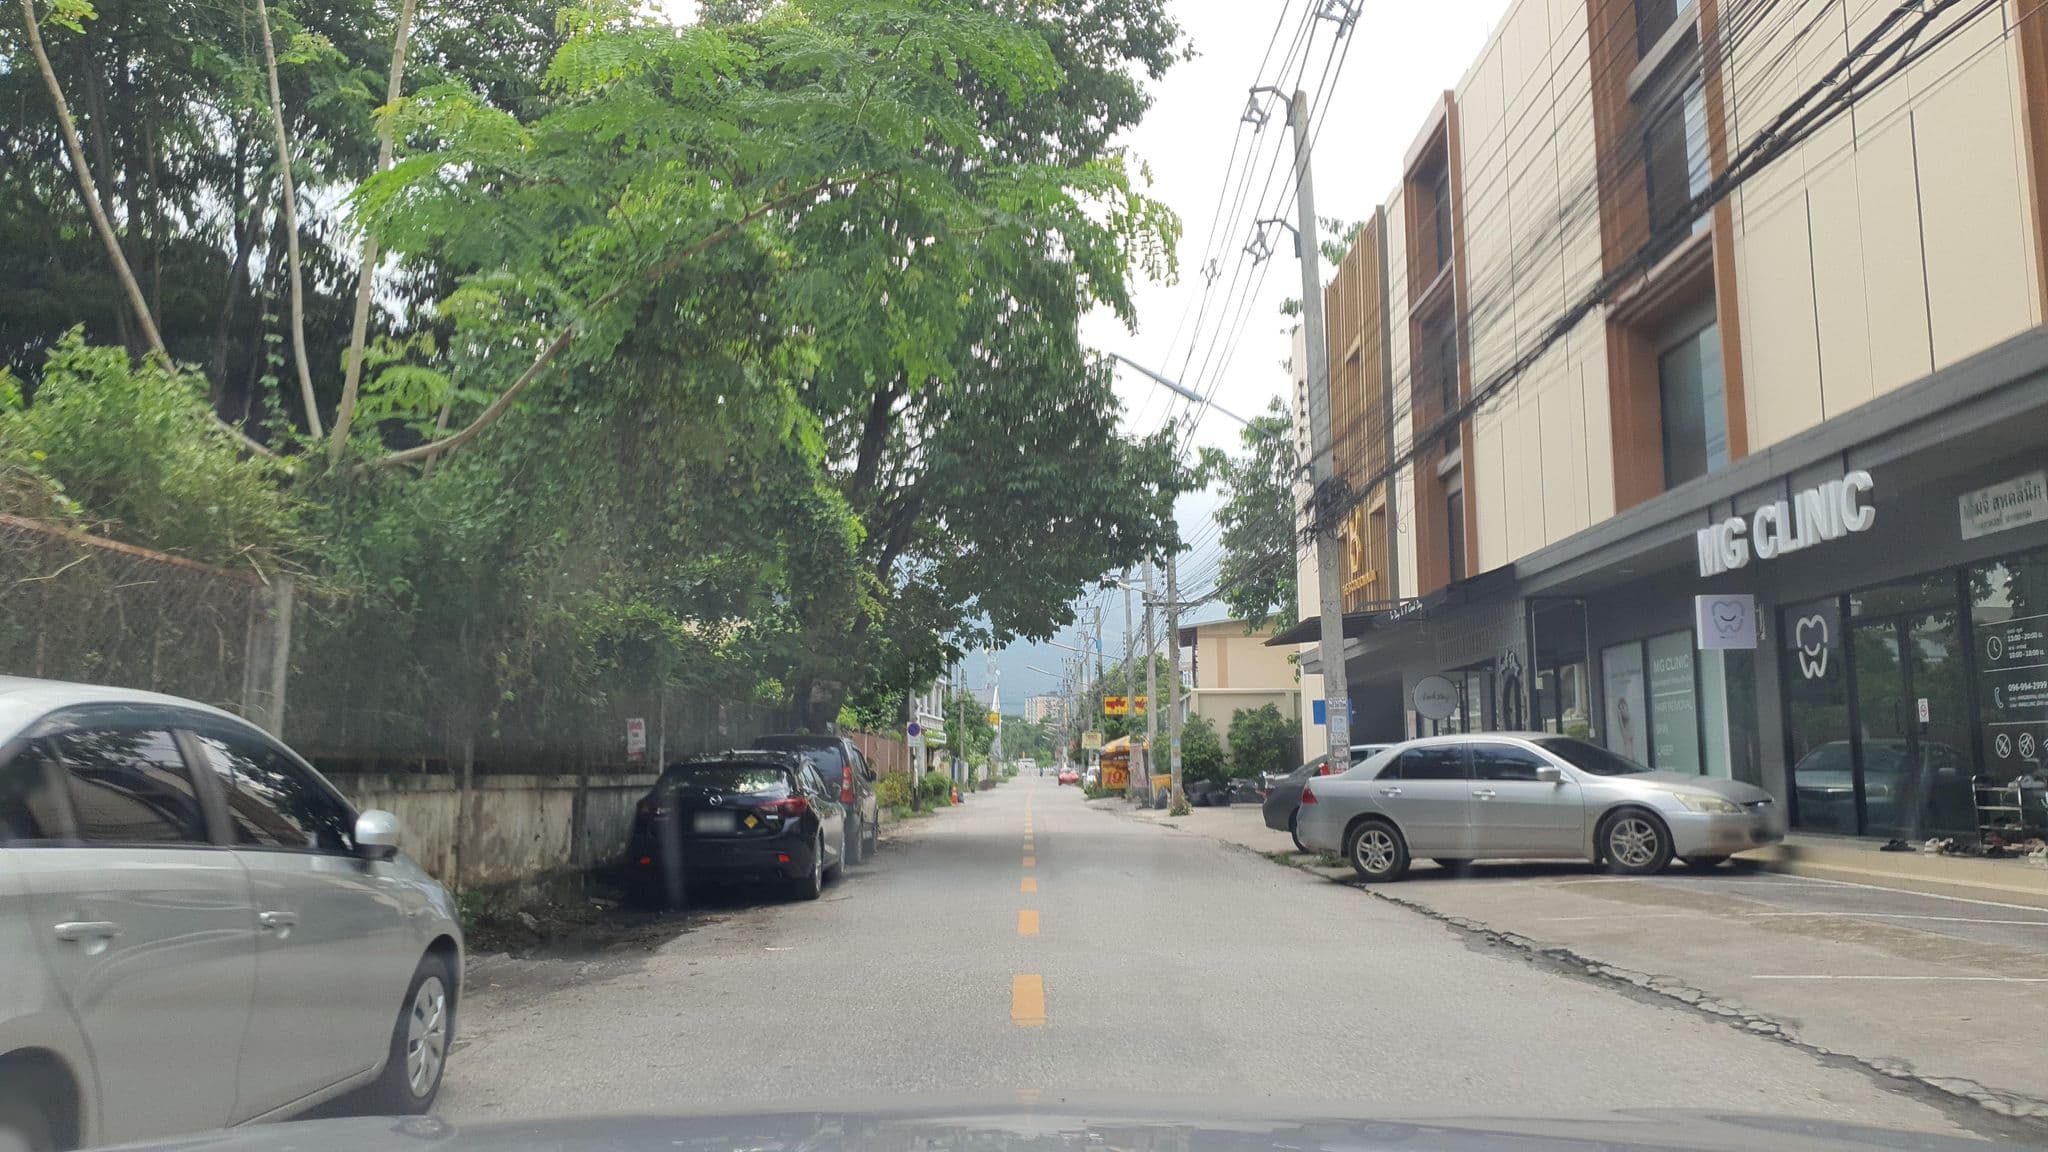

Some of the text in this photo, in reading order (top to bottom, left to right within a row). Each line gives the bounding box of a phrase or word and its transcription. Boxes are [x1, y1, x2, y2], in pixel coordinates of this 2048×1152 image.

[1697, 470, 1876, 577] MG CLINIC
[1653, 658, 1665, 673] MG
